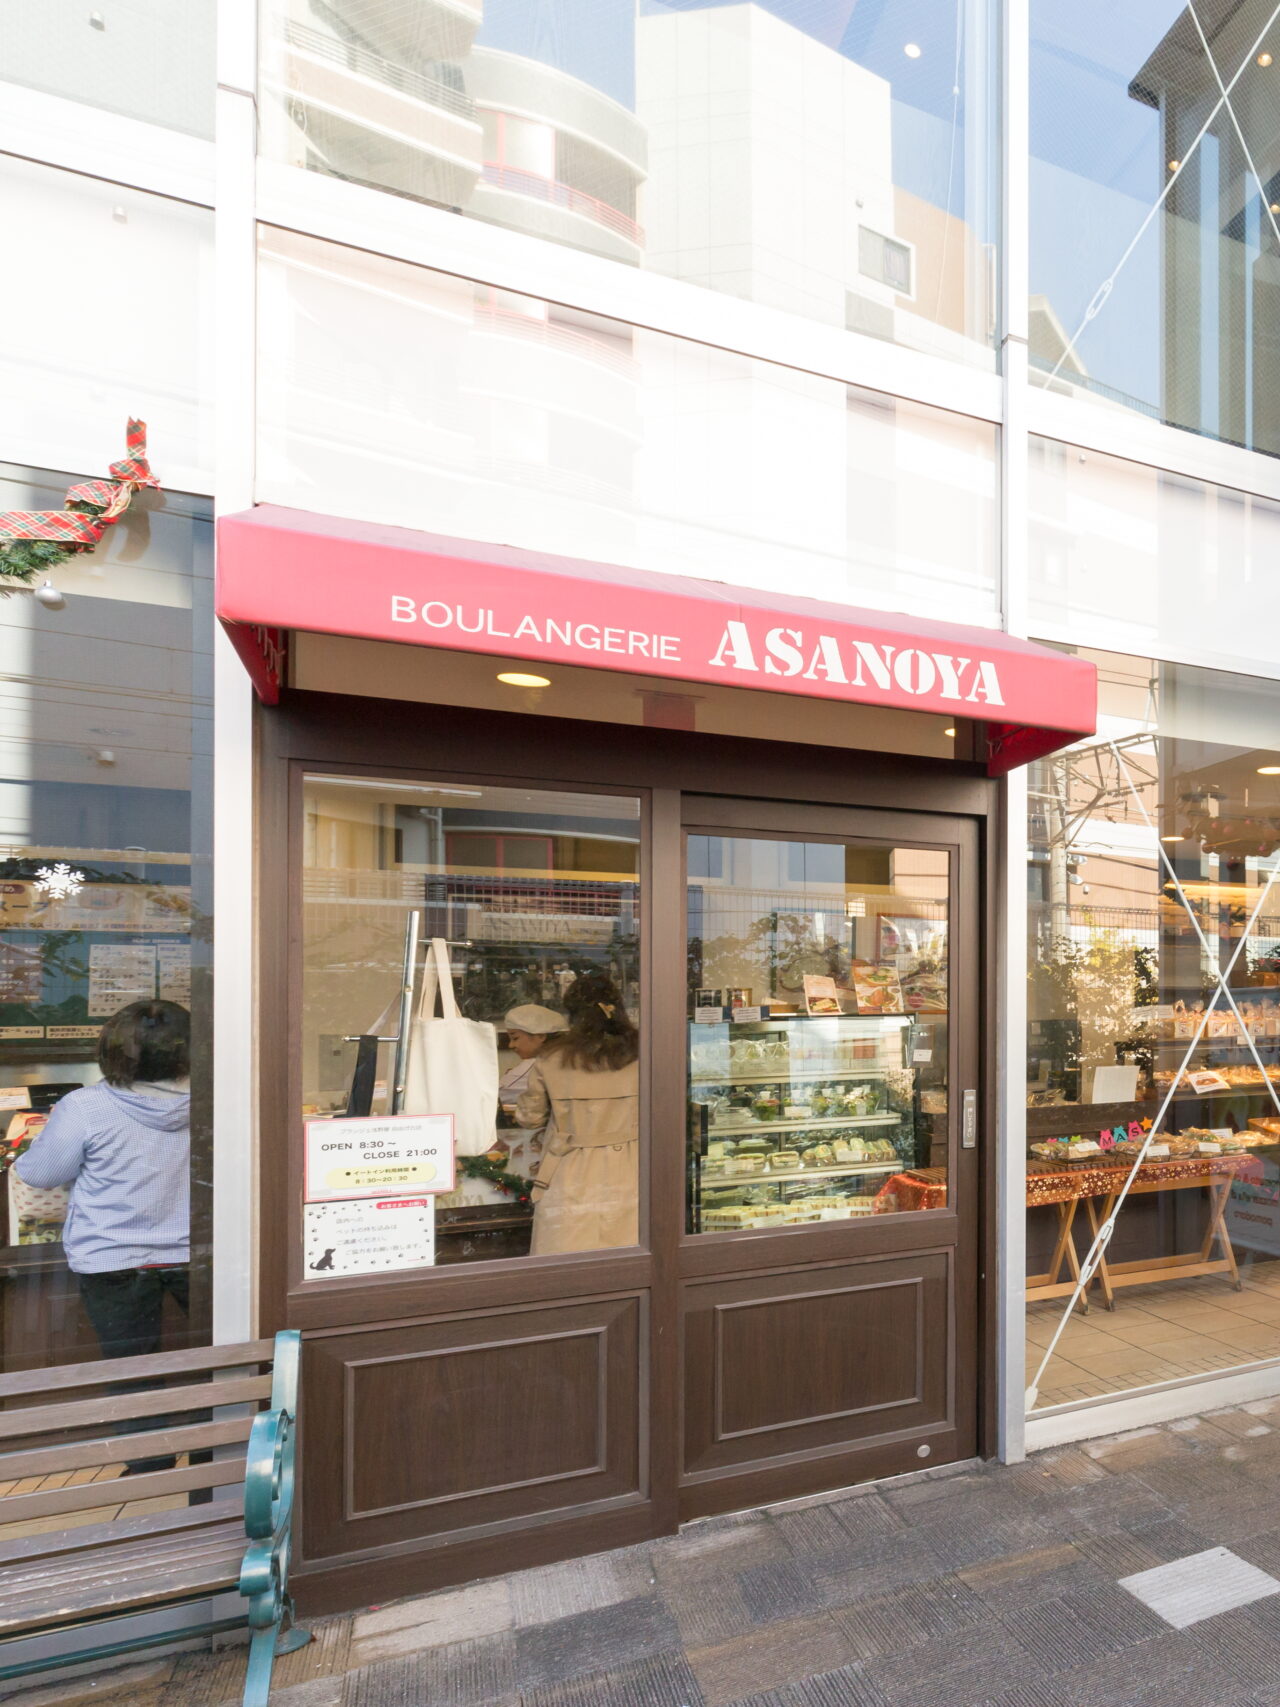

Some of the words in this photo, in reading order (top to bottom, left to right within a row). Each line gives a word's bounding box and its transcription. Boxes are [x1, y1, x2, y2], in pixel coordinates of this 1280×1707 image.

[390, 594, 681, 661] BOULANGERIE
[709, 619, 1005, 706] ASANOYA
[321, 1142, 353, 1152] OPEN
[363, 1150, 400, 1160] CLOSE
[406, 1148, 438, 1158] 21:00
